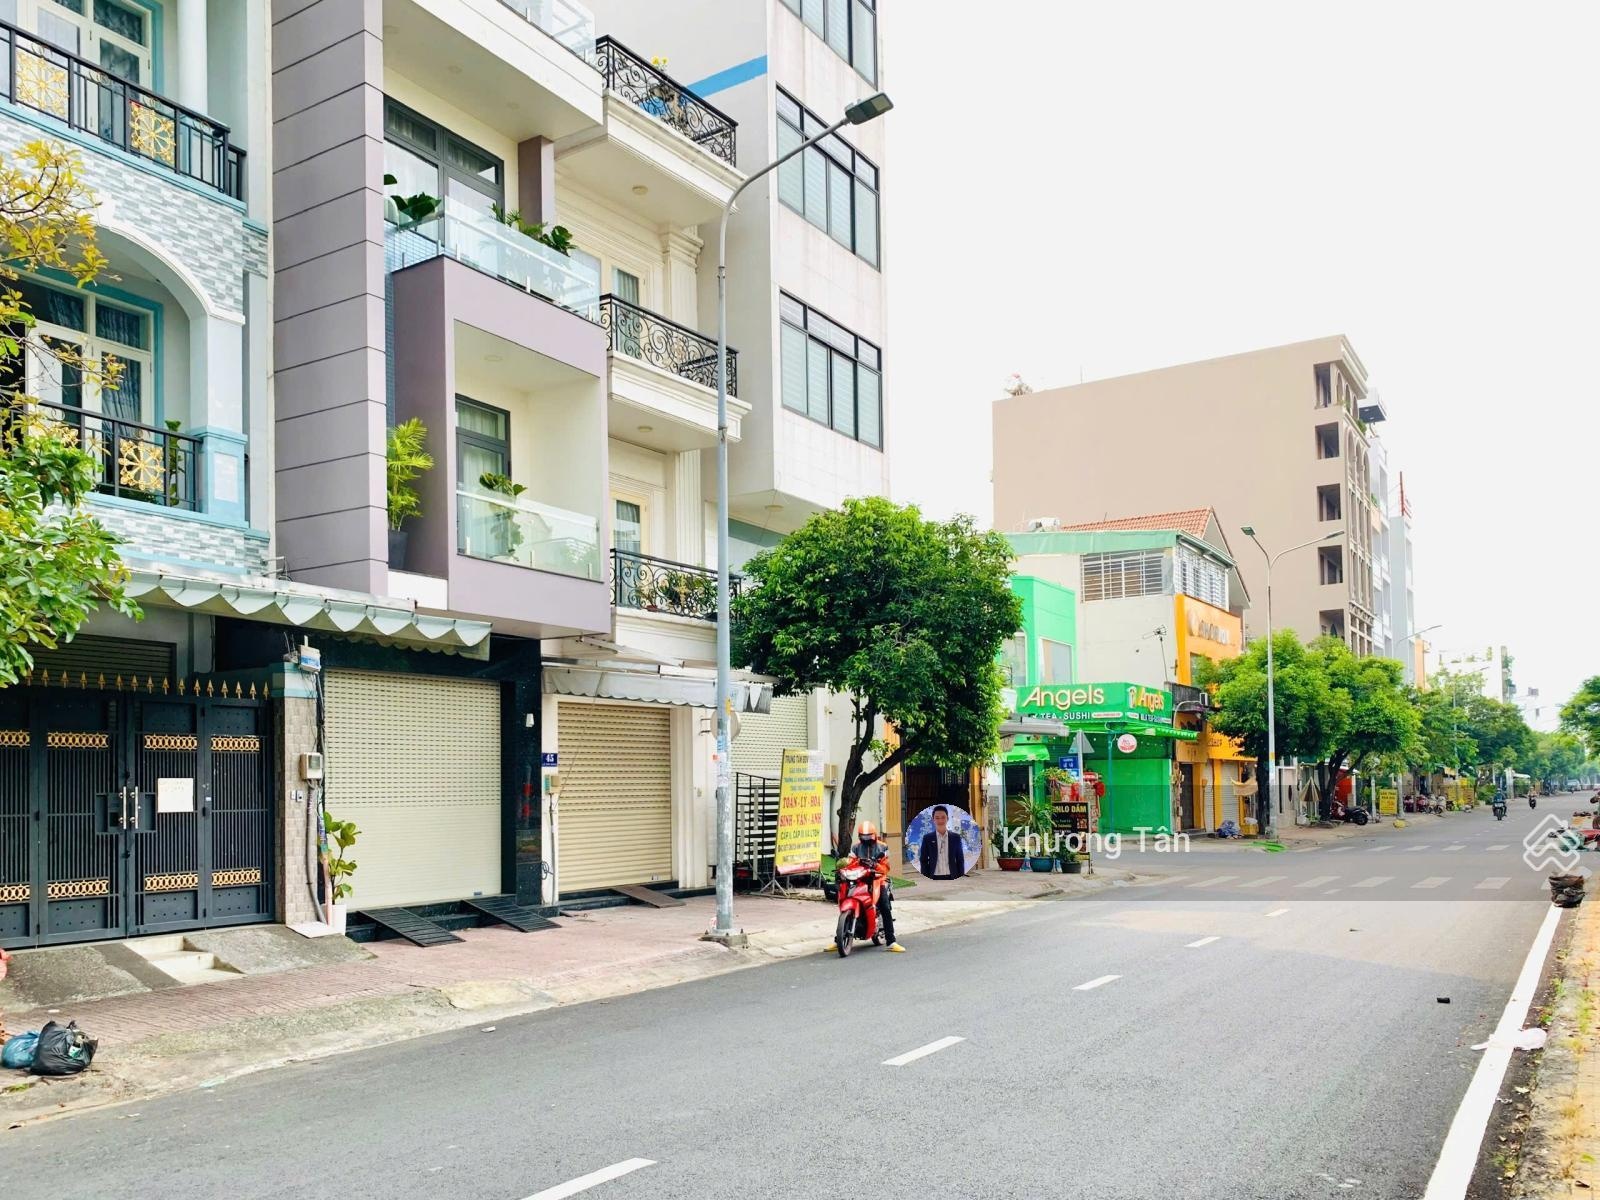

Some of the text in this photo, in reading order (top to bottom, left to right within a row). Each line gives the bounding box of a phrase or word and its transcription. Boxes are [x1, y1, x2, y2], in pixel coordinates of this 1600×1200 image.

[1022, 684, 1105, 711] Angels
[1063, 712, 1090, 720] SUSHI
[545, 754, 554, 762] 45
